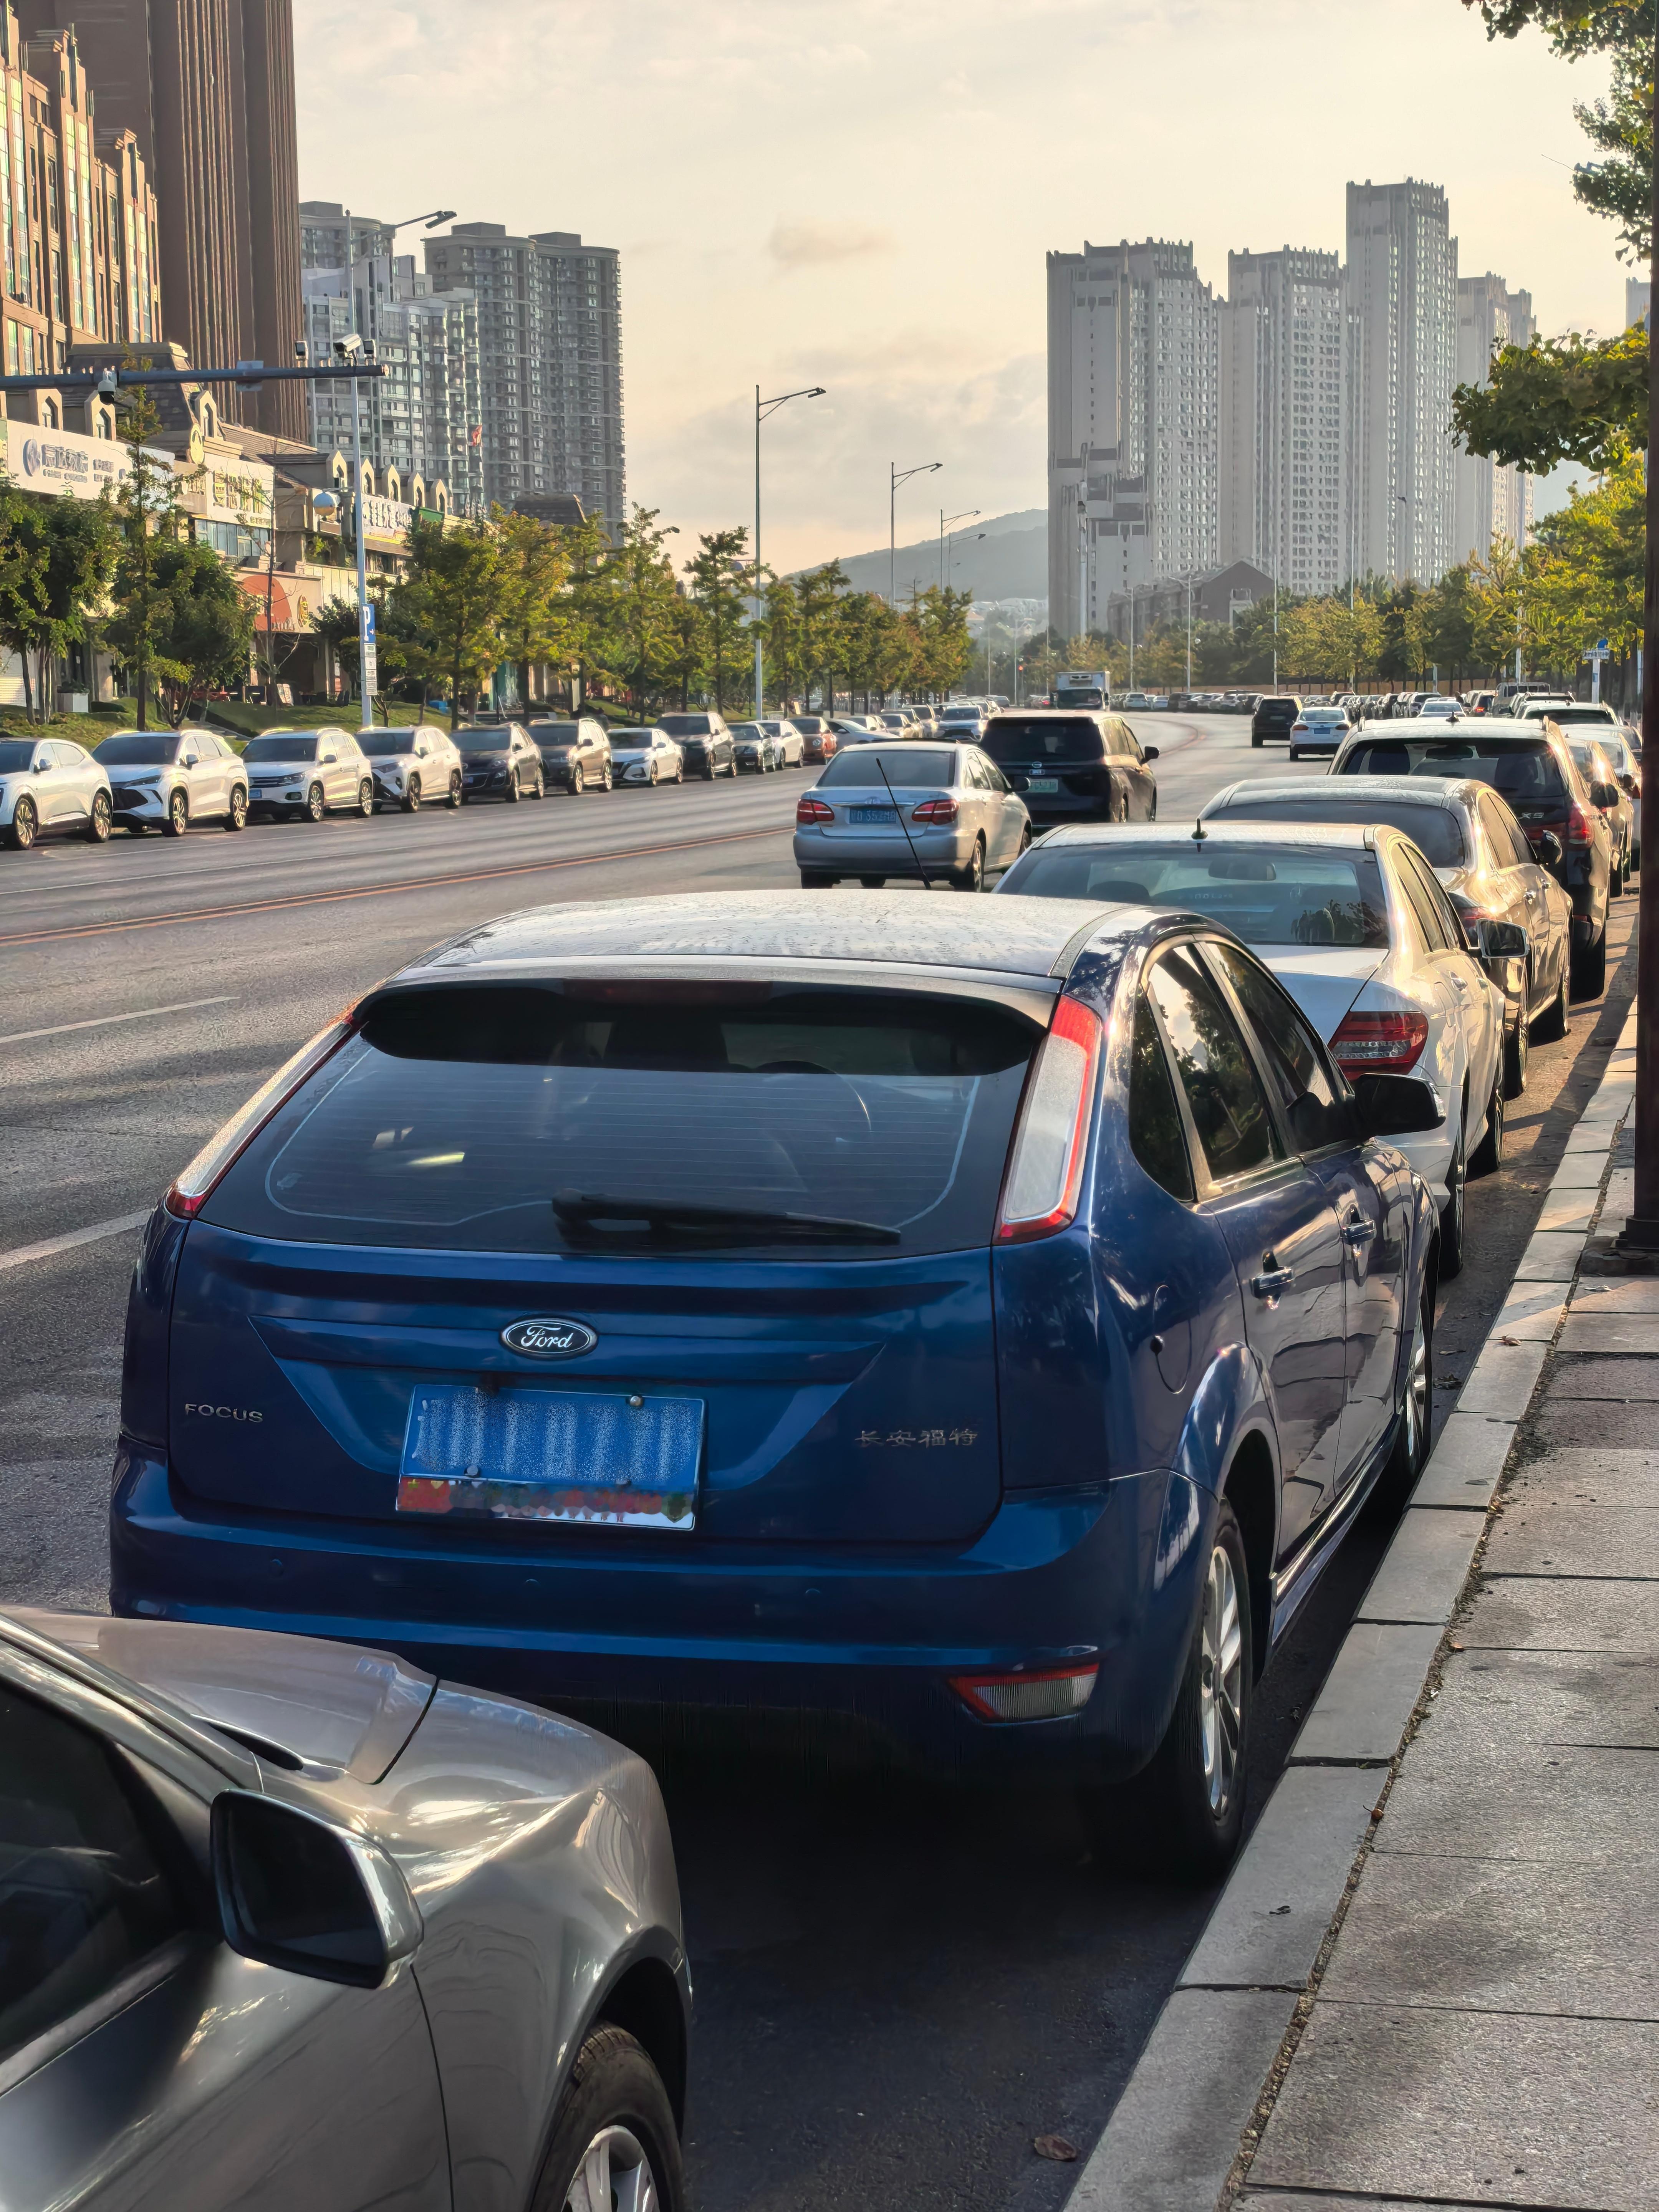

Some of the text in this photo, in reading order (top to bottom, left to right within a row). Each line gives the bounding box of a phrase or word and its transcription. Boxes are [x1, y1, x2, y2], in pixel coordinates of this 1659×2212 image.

[362, 606, 371, 641] P
[521, 1326, 574, 1348] Ford
[185, 1403, 263, 1423] FOCUS
[854, 1428, 978, 1449] 长安福特
